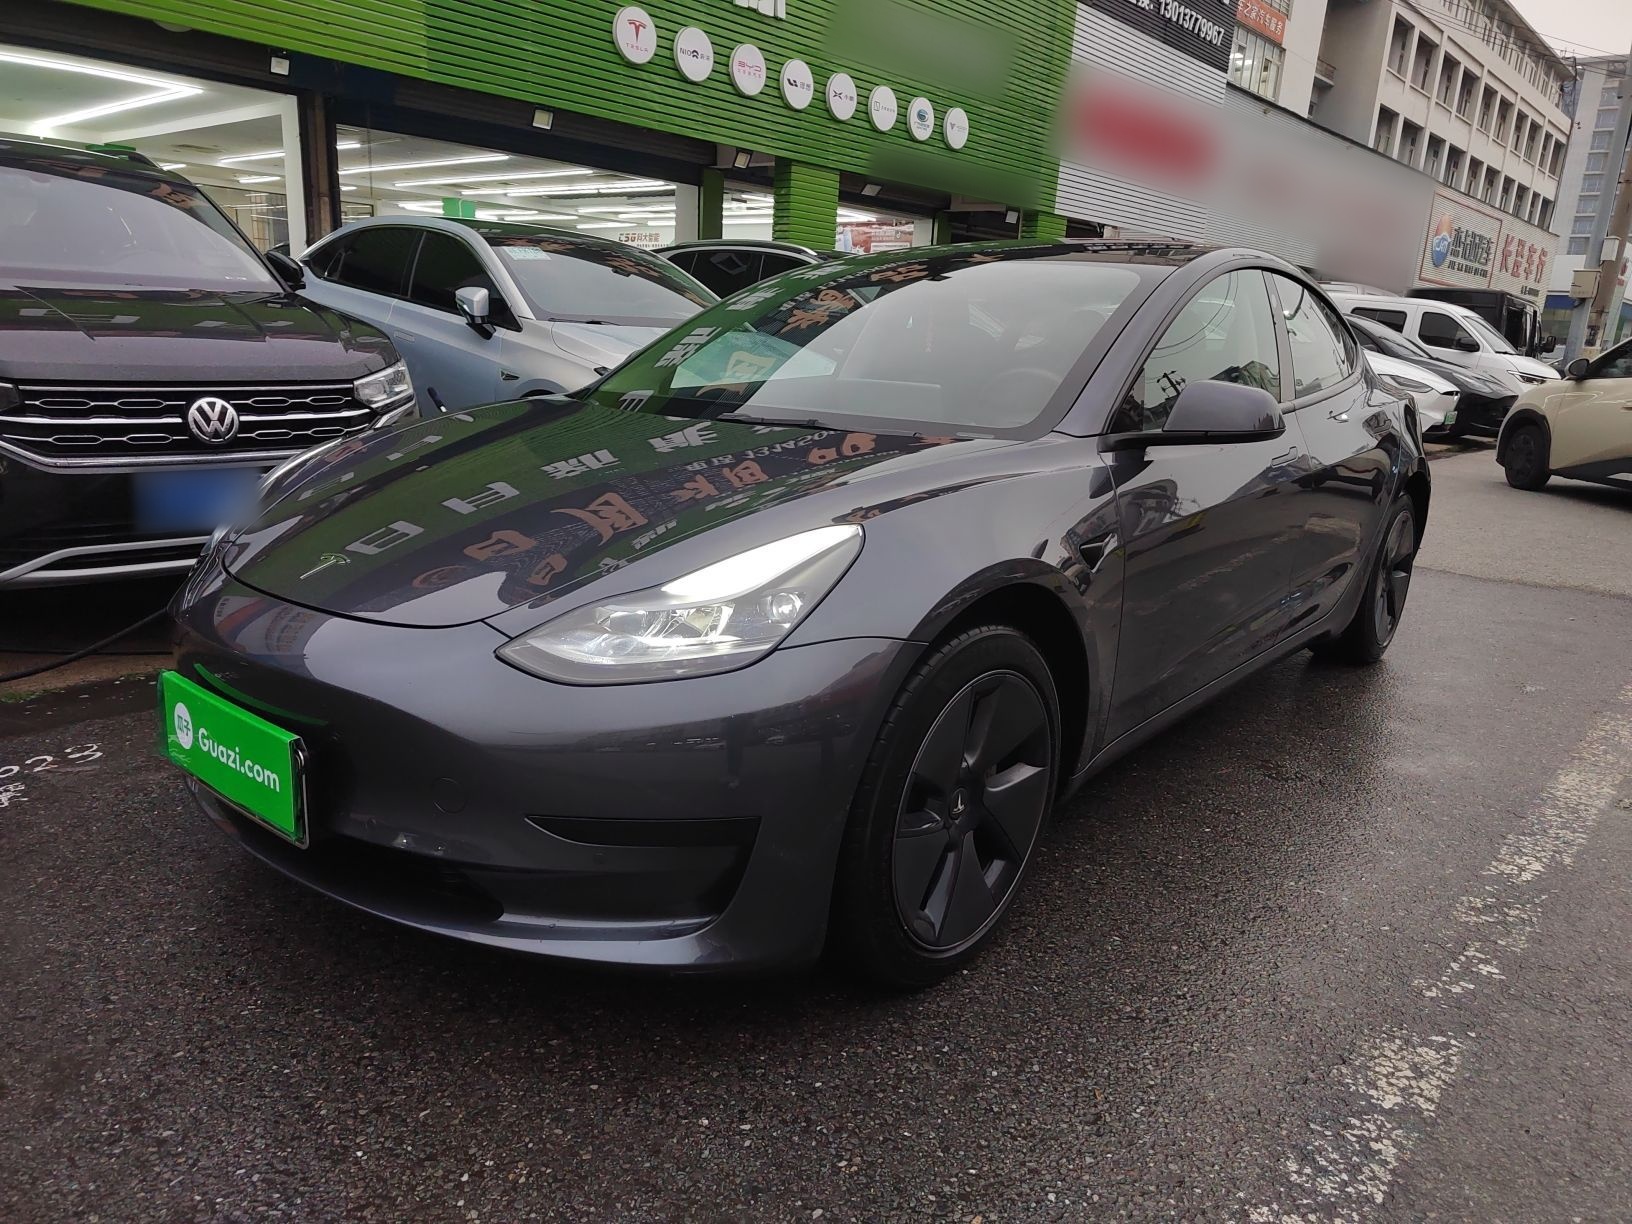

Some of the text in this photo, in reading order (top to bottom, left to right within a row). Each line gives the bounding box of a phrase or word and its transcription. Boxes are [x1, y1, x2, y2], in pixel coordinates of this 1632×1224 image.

[1159, 0, 1225, 46] 13013779967
[679, 47, 692, 57] NIO
[198, 727, 280, 793] Guazi.com
